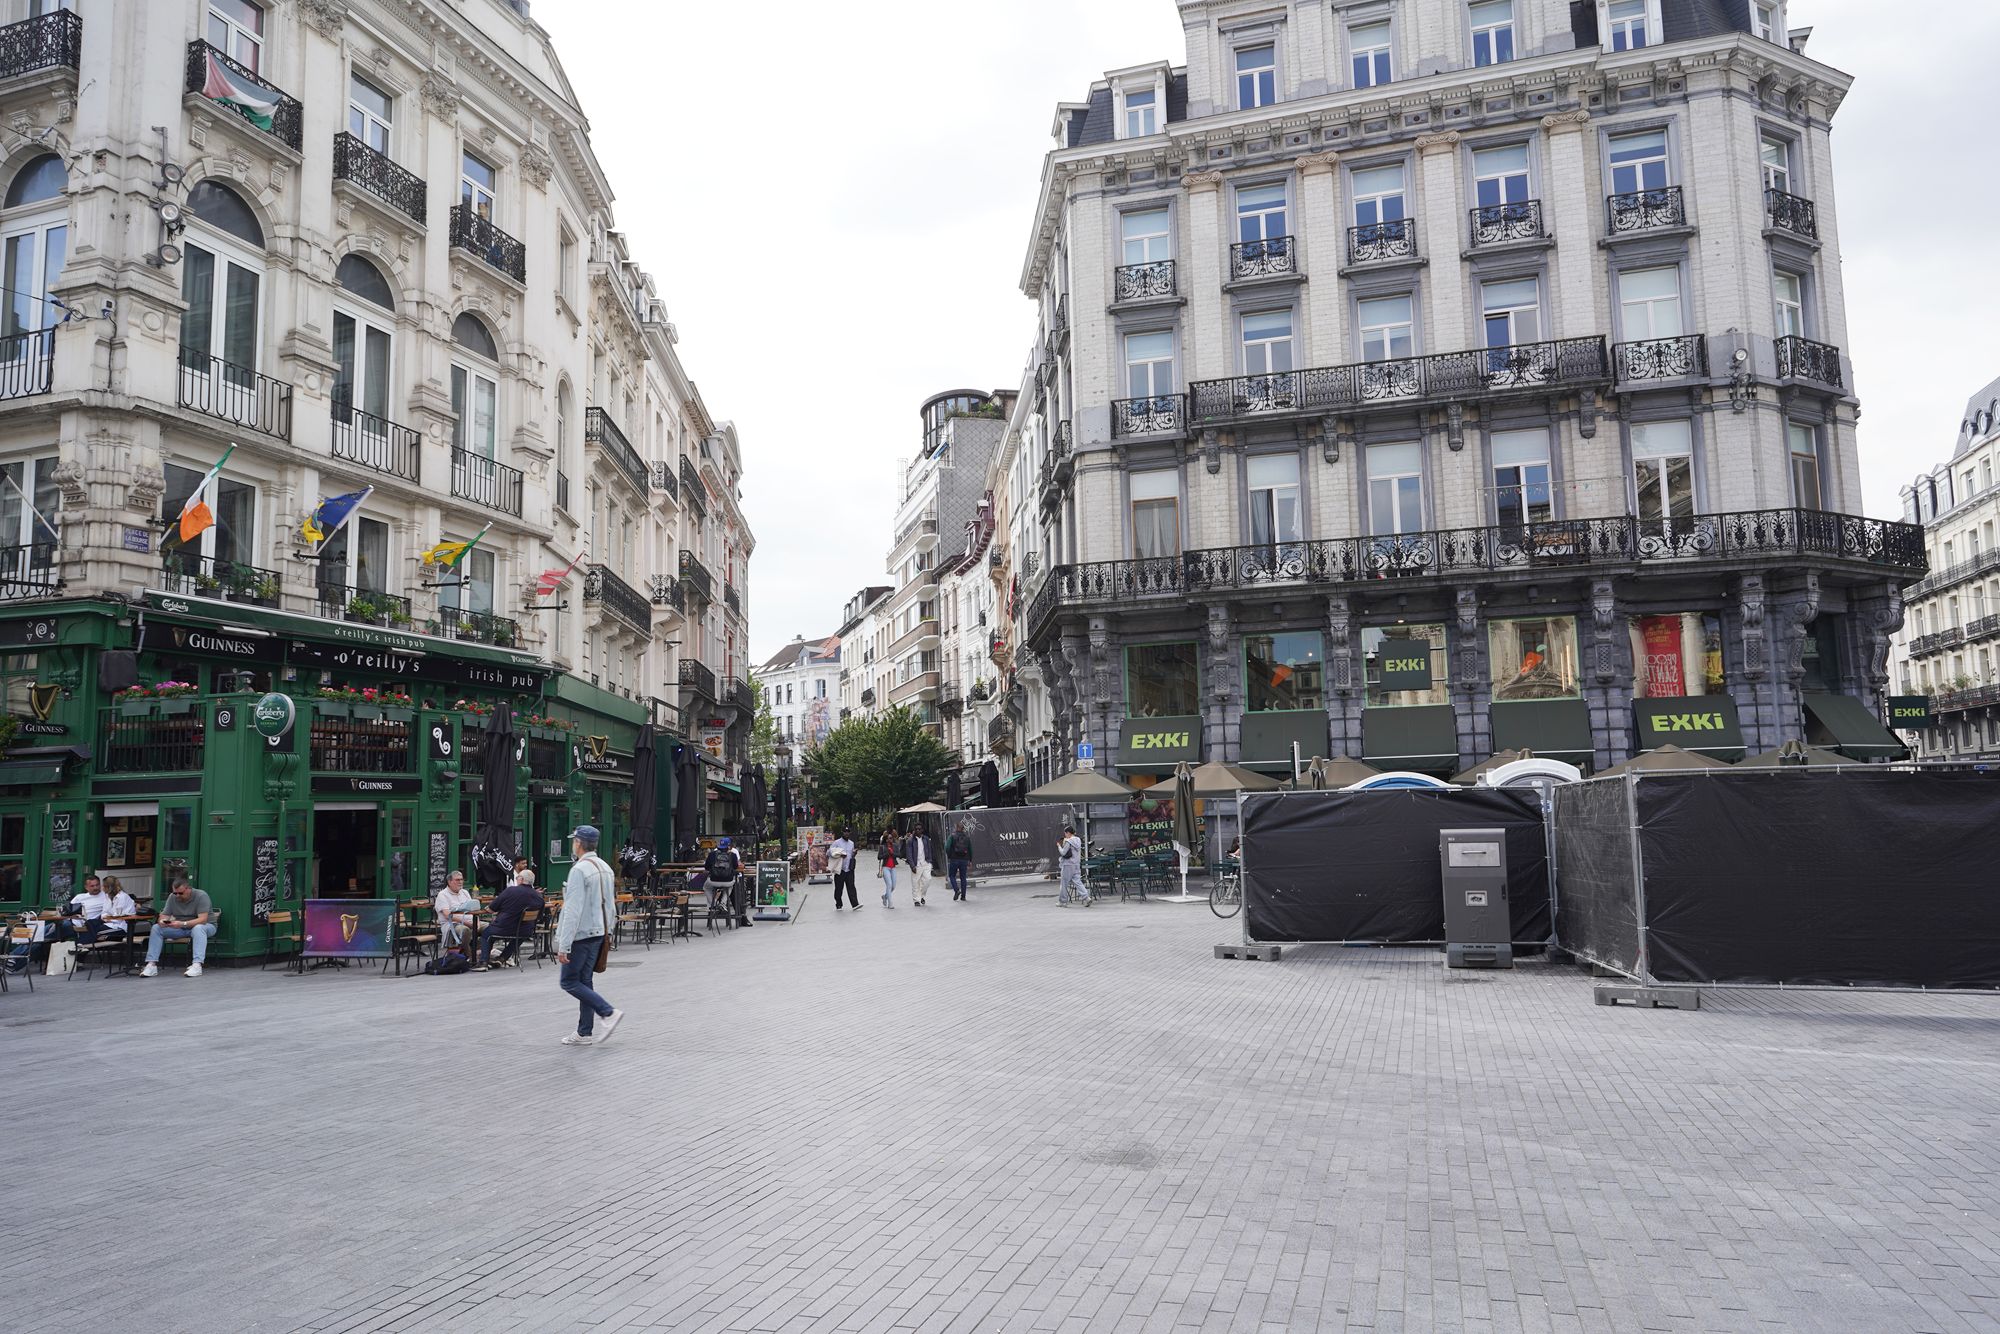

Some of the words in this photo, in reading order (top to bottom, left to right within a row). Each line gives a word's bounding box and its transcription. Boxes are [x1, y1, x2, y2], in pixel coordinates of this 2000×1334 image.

[161, 598, 189, 613] Carlsberg
[188, 633, 256, 655] GUINNESS
[384, 634, 406, 646] irish
[408, 639, 425, 649] pub
[469, 666, 503, 684] irish
[511, 674, 534, 688] pub
[256, 706, 285, 720] Carlsberg
[25, 723, 64, 734] GUINNESS
[358, 780, 393, 790] GUINNESS
[999, 831, 1029, 841] SOLID
[385, 914, 393, 943] GUINNESS
